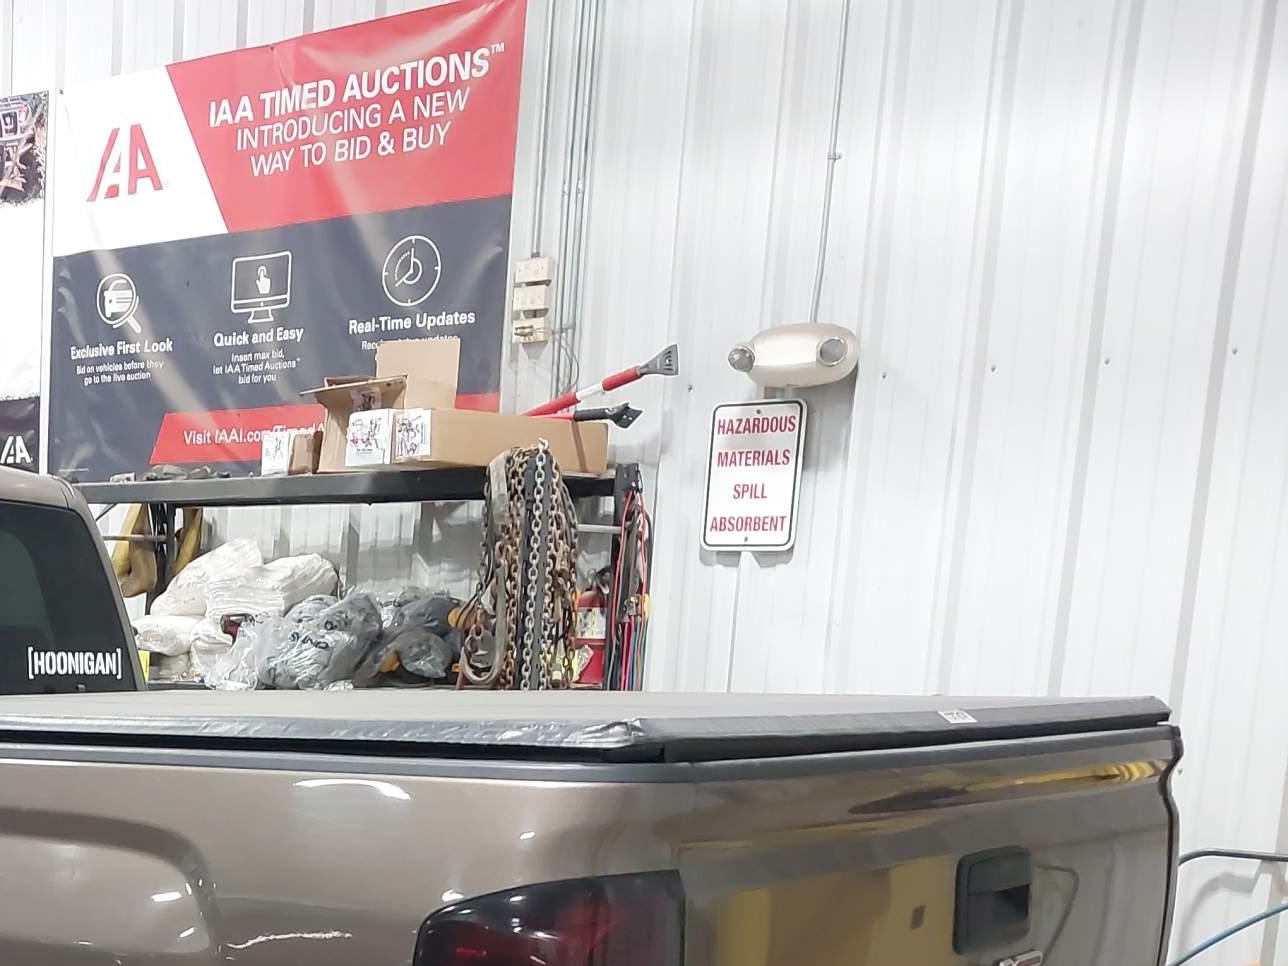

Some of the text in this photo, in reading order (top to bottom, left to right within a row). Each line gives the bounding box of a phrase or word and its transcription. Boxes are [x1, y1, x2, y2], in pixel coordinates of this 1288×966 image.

[209, 96, 254, 128] IAA
[259, 79, 335, 119] TIMED
[235, 87, 470, 150] INTRODUCING A NEW
[250, 121, 452, 177] WAY TO BID & BUY
[349, 310, 476, 335] Real-Time Updates
[214, 326, 304, 347] Quick and Easy
[70, 338, 173, 360] Exclusive First Look
[232, 352, 253, 363] Insert
[254, 351, 270, 361] max
[76, 365, 86, 375] Bid
[96, 362, 123, 373] vehicles
[124, 360, 145, 370] before
[146, 359, 165, 369] they
[213, 365, 223, 375] let
[225, 363, 241, 374] IAA
[241, 361, 264, 373] Timed
[101, 373, 112, 383] the
[127, 371, 151, 381] auction
[238, 373, 277, 385] bid for you
[717, 415, 796, 435] HAZARDOUS
[183, 429, 212, 446] Visit
[717, 449, 790, 468] MATERIALS
[733, 483, 767, 499] SPILL
[710, 515, 787, 532] ABSORBENT
